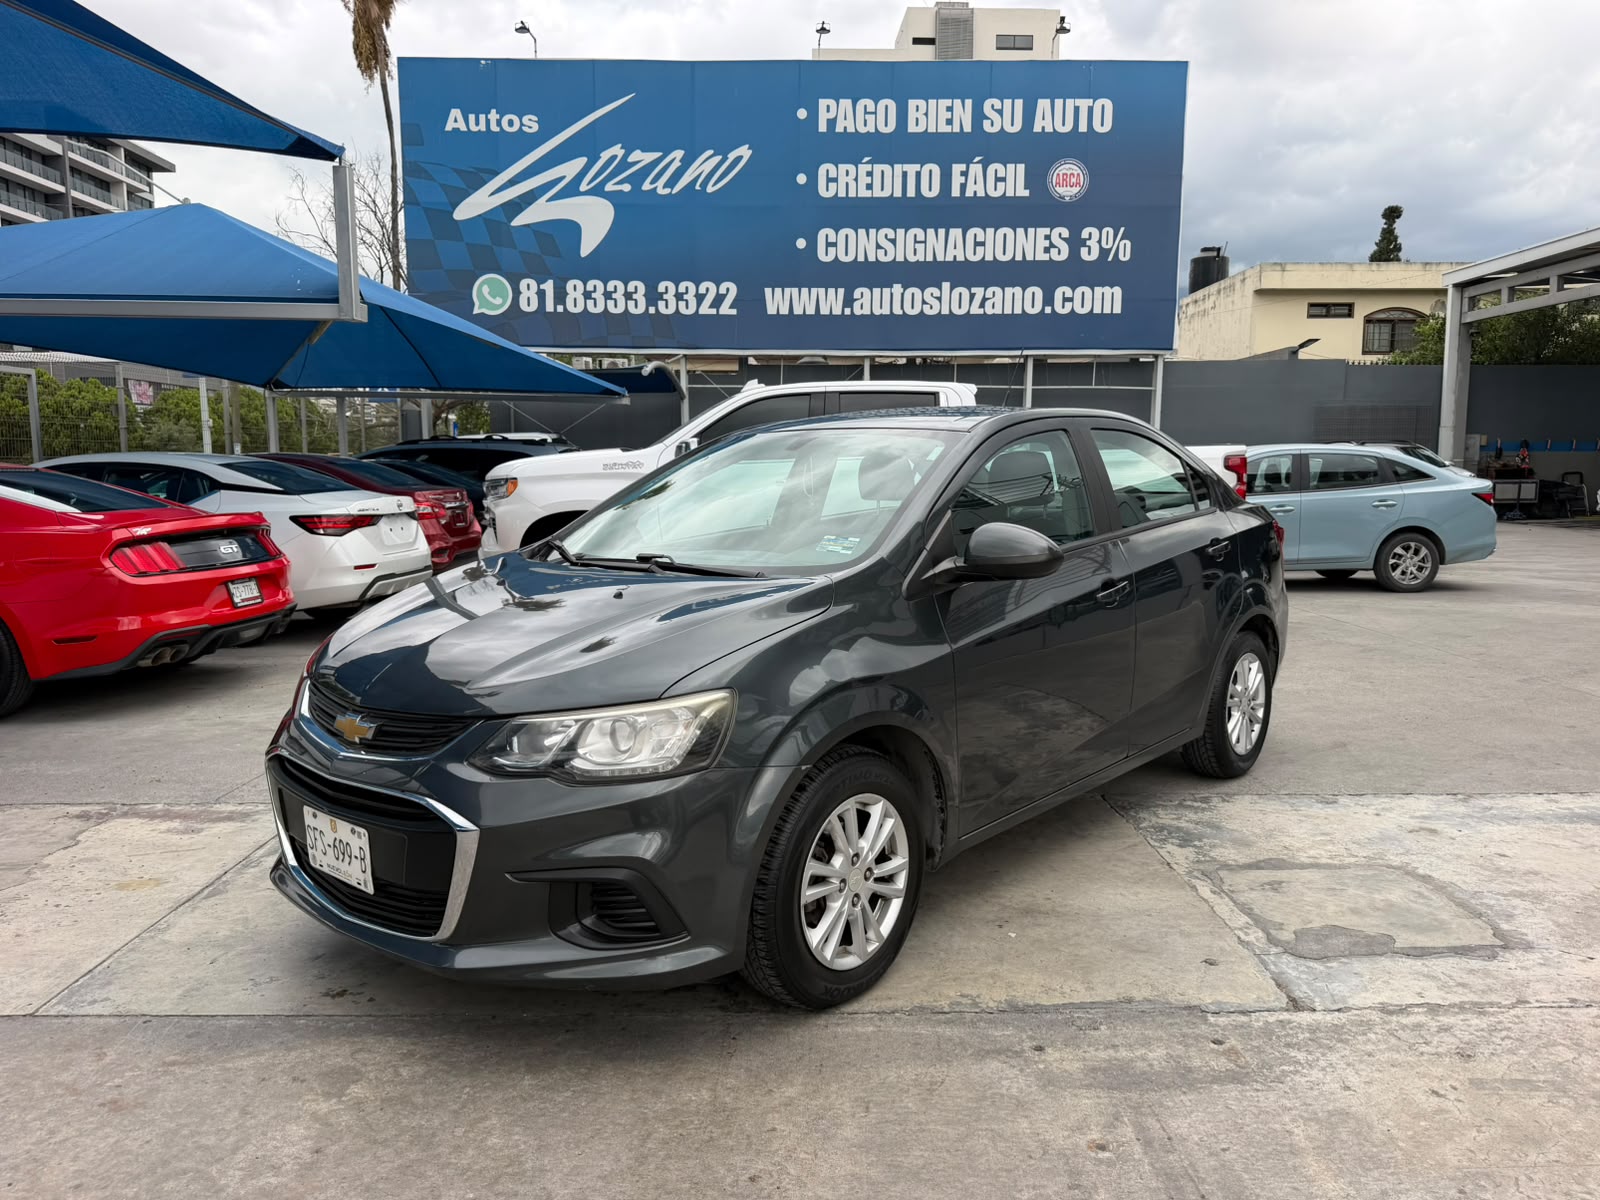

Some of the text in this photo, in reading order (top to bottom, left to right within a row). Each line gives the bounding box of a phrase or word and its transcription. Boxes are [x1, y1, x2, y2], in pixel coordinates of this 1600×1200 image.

[444, 108, 539, 133] Autos
[818, 98, 1114, 134] PAGO BIEN SU AUTO
[452, 92, 753, 258] Lozano
[817, 156, 1030, 198] CRÉDITO FÁCIL
[1054, 172, 1082, 188] ARCA
[817, 226, 1132, 263] CONSIGNACIONES 3%
[519, 278, 738, 315] 81.8333.3322
[764, 281, 1123, 316] www.autoslozano.com
[219, 544, 239, 554] GT
[306, 823, 367, 874] SFS-699-B
